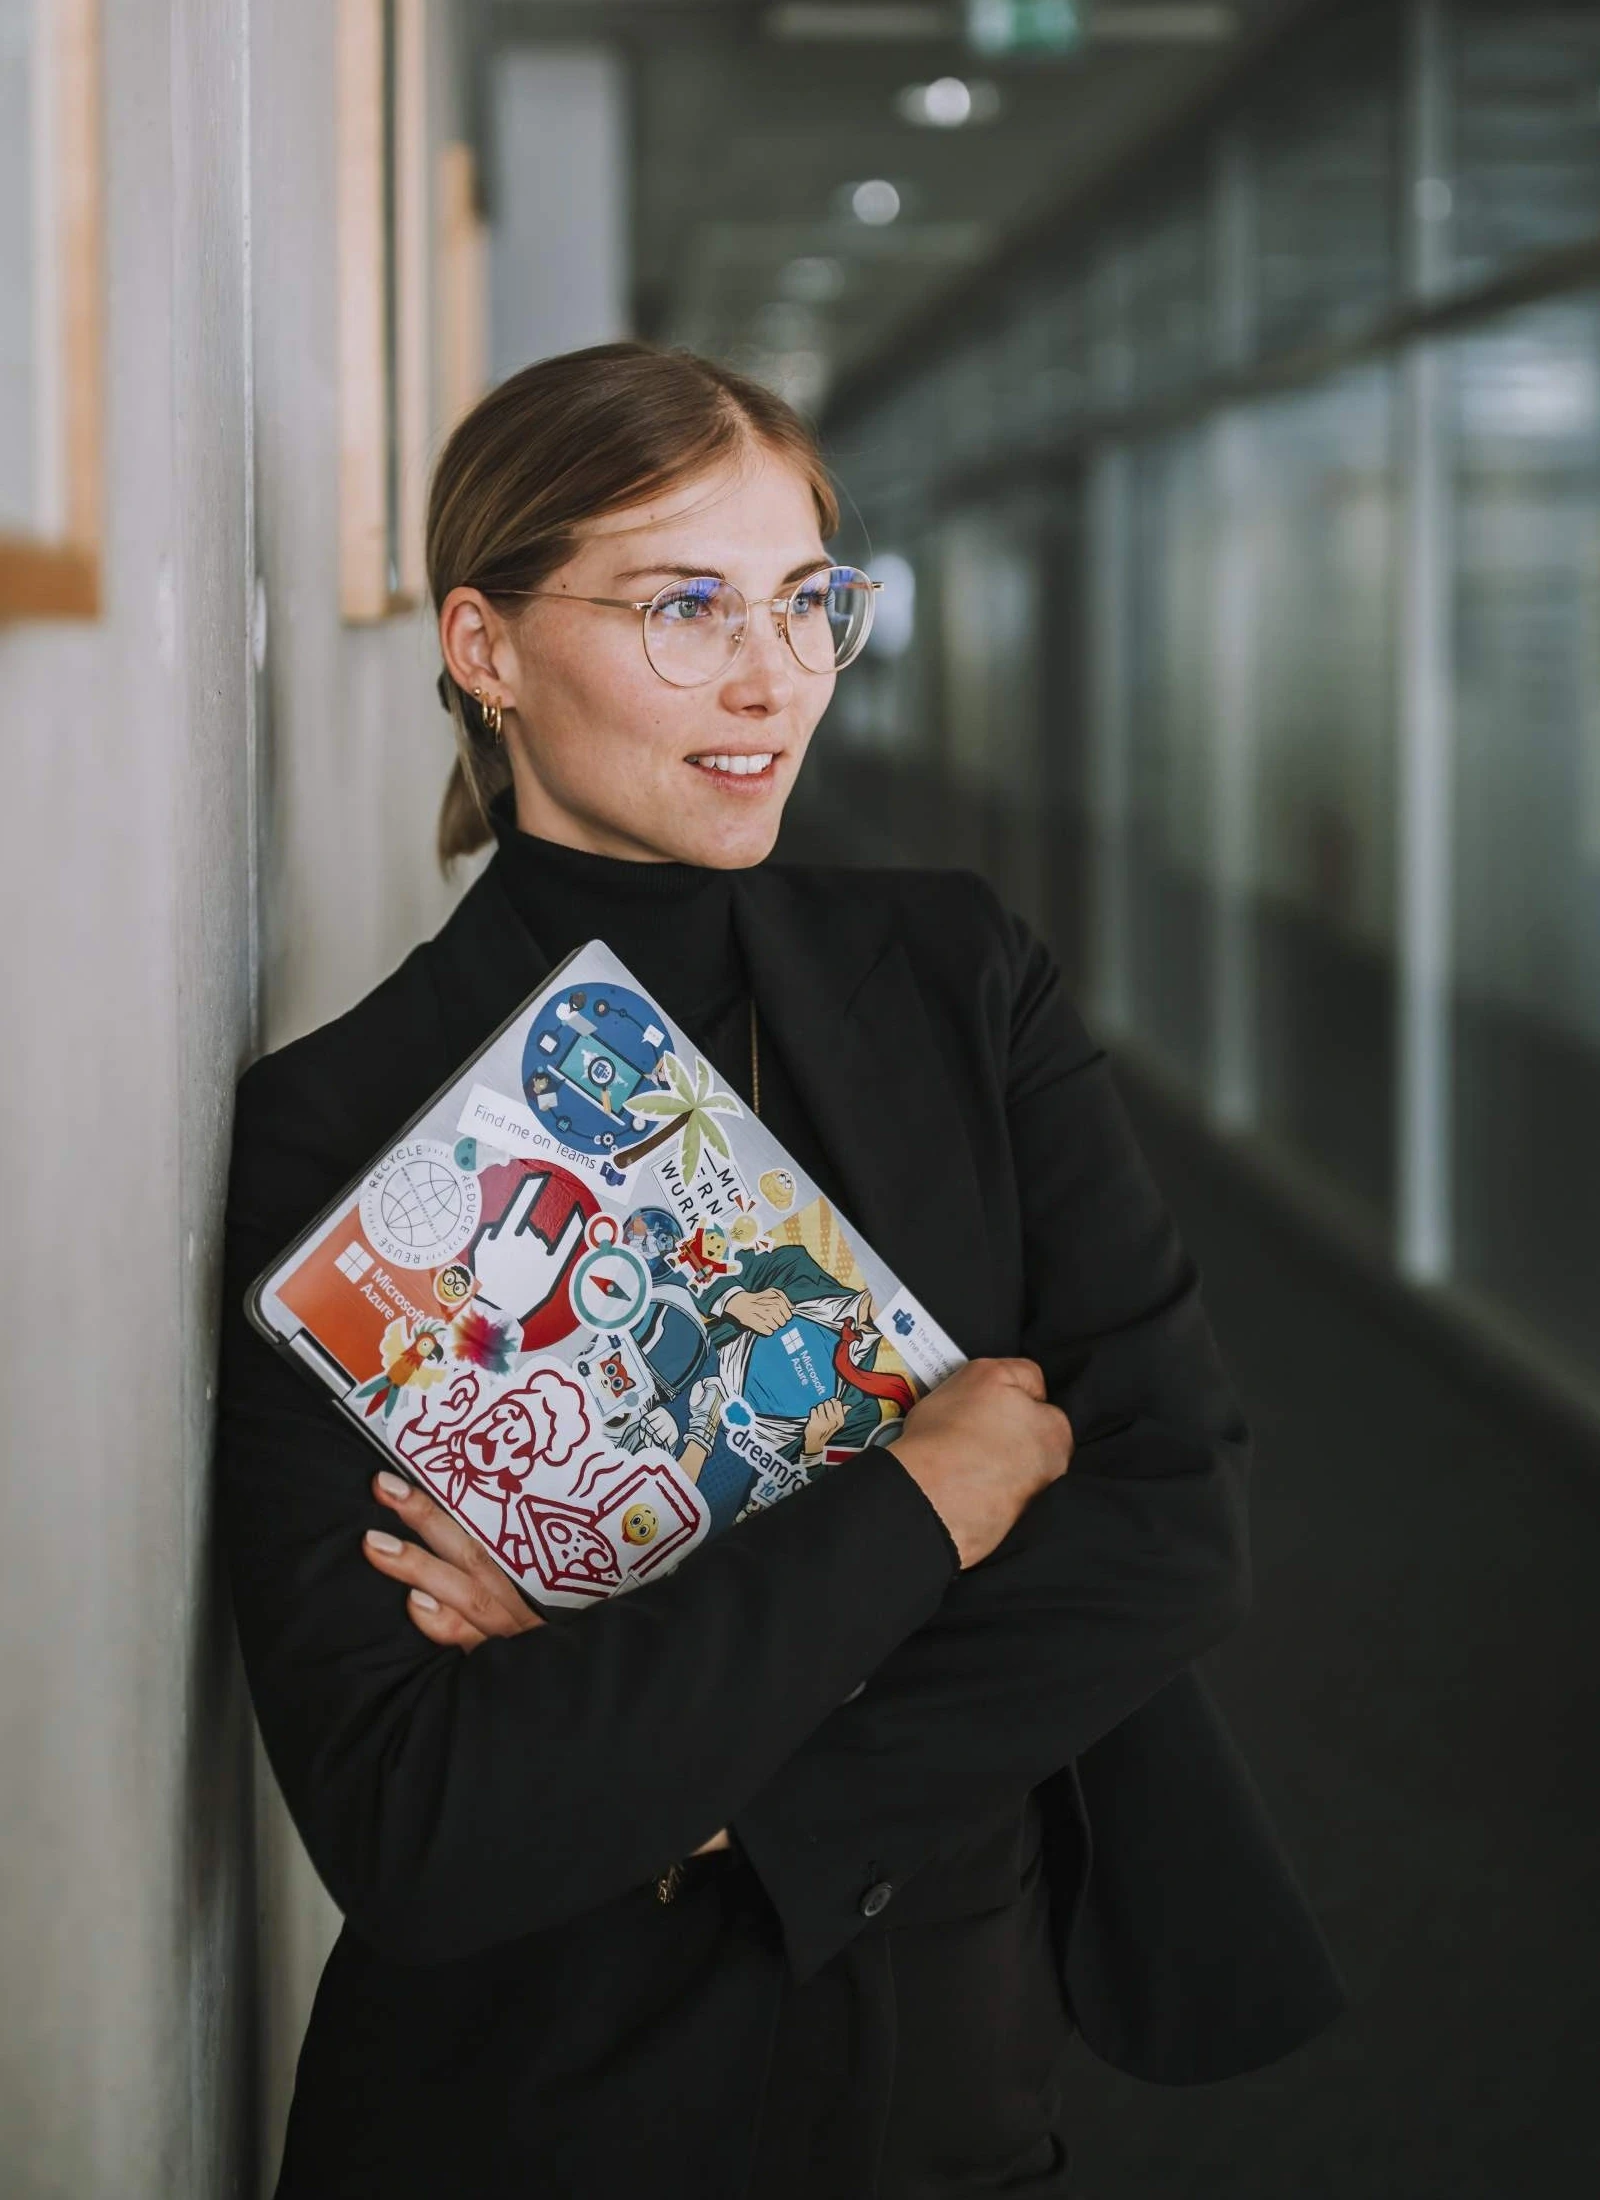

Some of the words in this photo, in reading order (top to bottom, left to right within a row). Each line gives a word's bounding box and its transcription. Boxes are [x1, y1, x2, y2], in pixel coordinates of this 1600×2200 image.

[474, 1104, 503, 1129] Find
[507, 1122, 530, 1140] me
[533, 1135, 551, 1150] on
[369, 1144, 423, 1189] RECYCLE
[661, 1160, 699, 1230] WURK
[379, 1237, 421, 1264] REUSE
[360, 1283, 395, 1320] Azure
[791, 1357, 809, 1386] Azure
[800, 1350, 826, 1396] Microsoft
